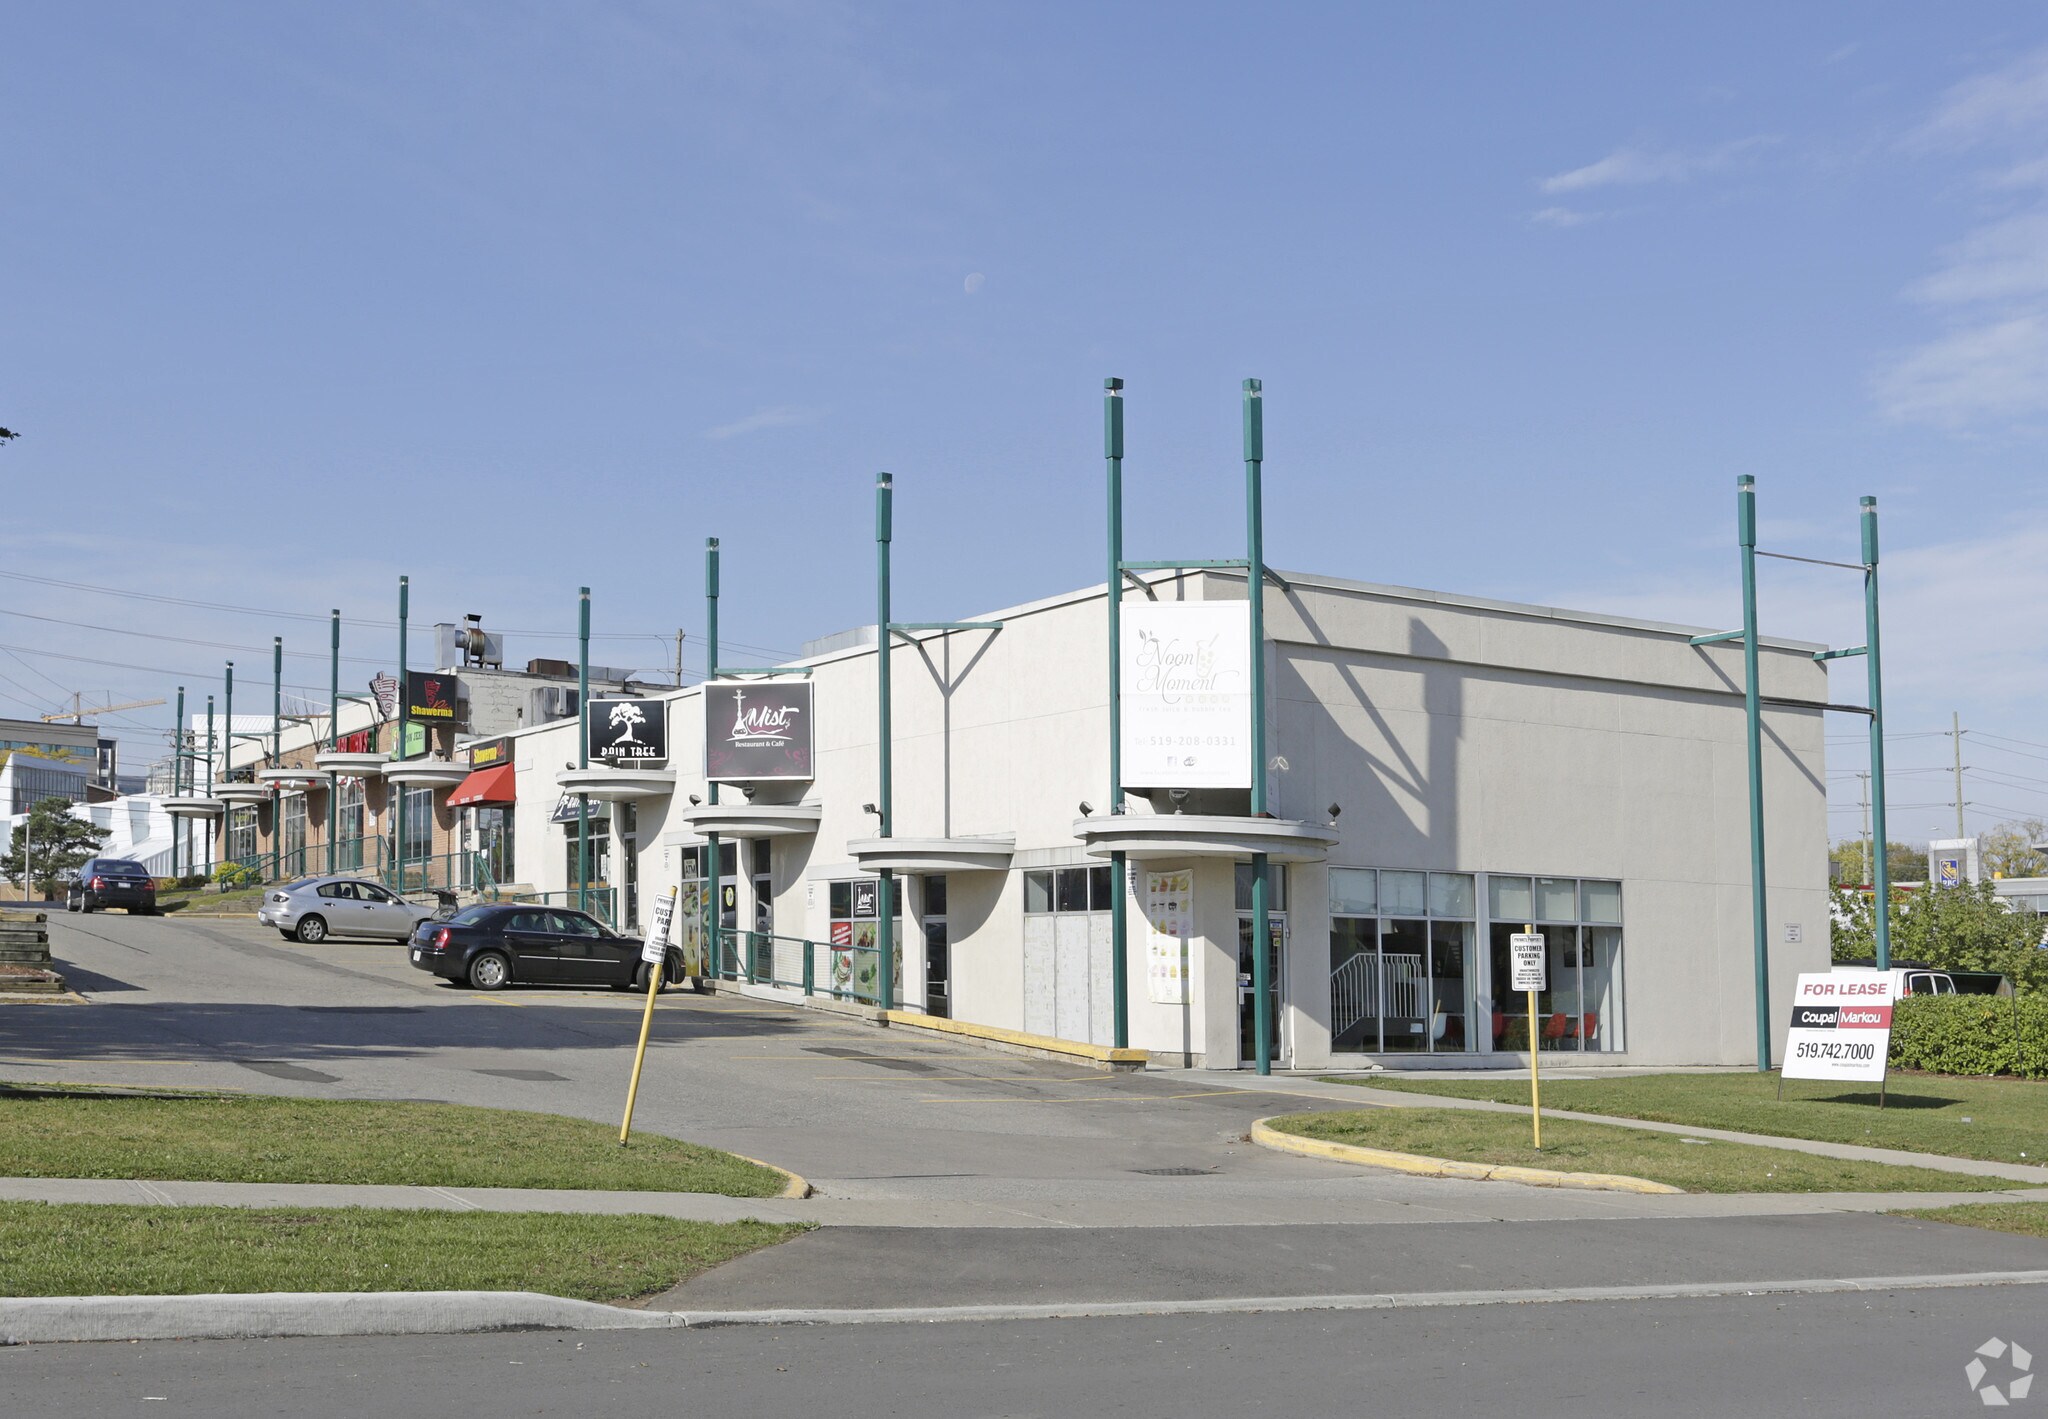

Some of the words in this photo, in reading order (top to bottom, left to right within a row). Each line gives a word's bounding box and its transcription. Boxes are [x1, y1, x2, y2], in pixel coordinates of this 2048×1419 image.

[1136, 636, 1193, 667] Noon
[1136, 663, 1240, 704] Moment
[411, 705, 453, 717] Shawerma
[748, 705, 800, 728] Mist
[1150, 736, 1236, 746] 519-208-0331
[630, 746, 656, 757] TREE
[1803, 984, 1835, 996] FOR
[1839, 983, 1888, 995] LEASE
[1801, 1011, 1838, 1025] Coupal
[1840, 1011, 1881, 1023] Markou
[1796, 1042, 1875, 1060] 519.742.7000
